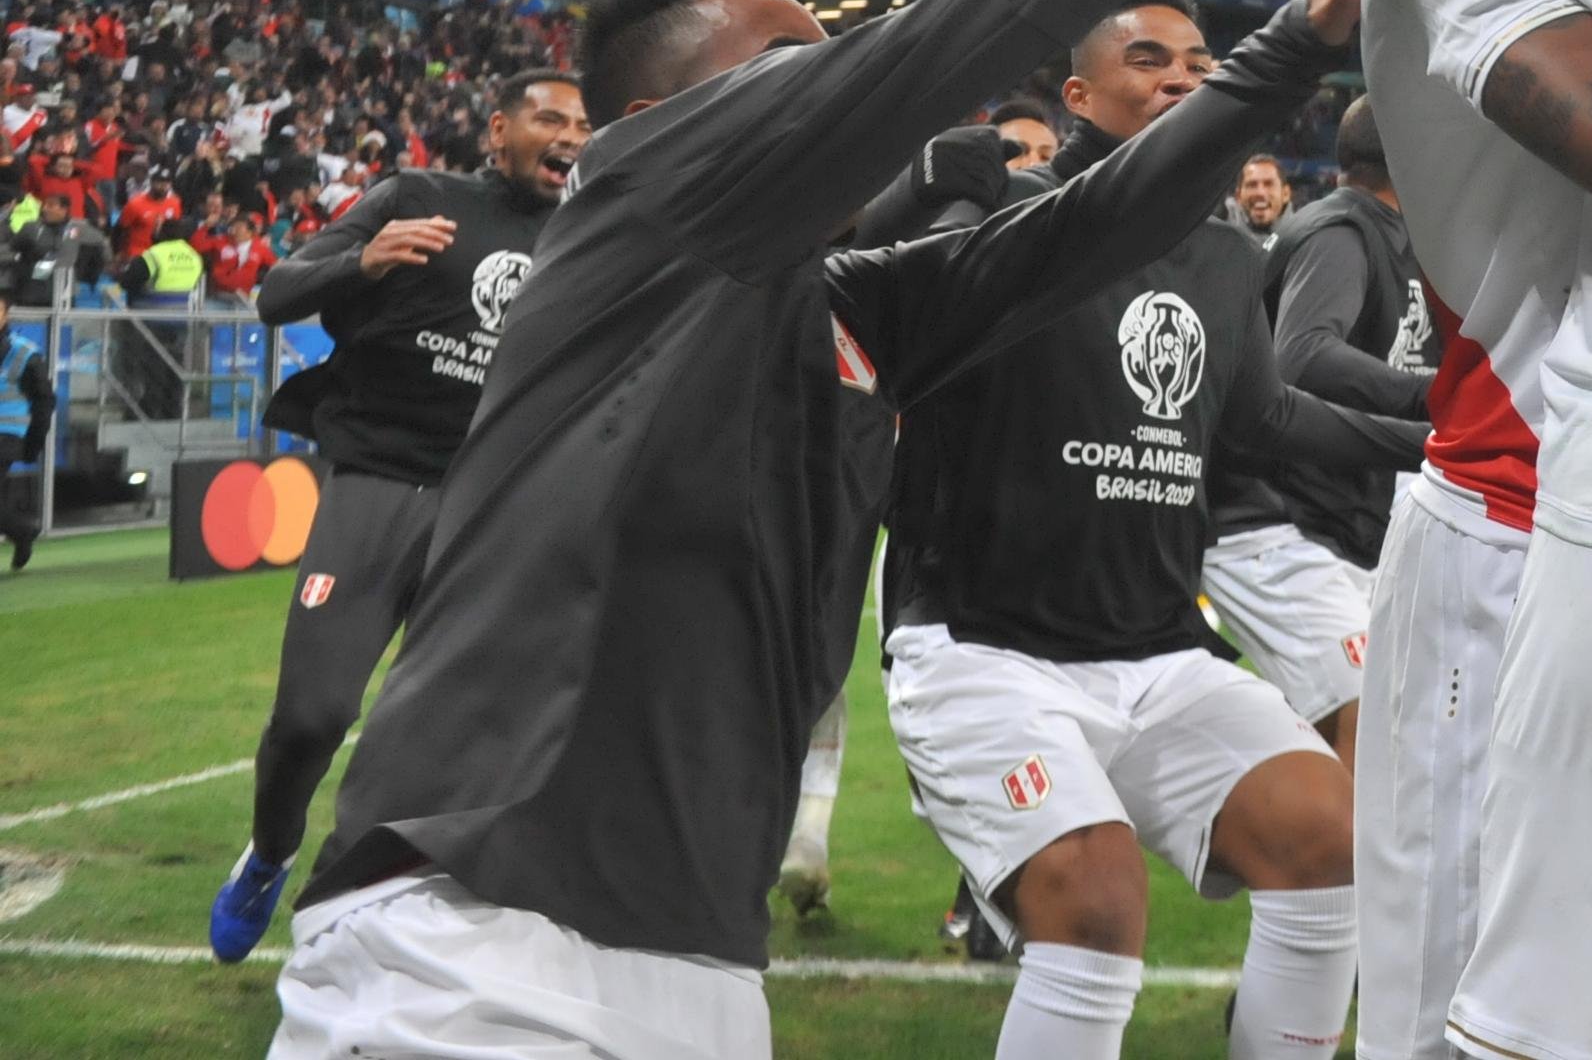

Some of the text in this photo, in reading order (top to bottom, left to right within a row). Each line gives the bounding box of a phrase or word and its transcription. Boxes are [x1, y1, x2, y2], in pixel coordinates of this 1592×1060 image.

[416, 330, 467, 360] COPA
[1136, 424, 1183, 447] CONMEBOL
[1062, 440, 1202, 479] COPA AMERIC
[1165, 482, 1195, 506] 2019
